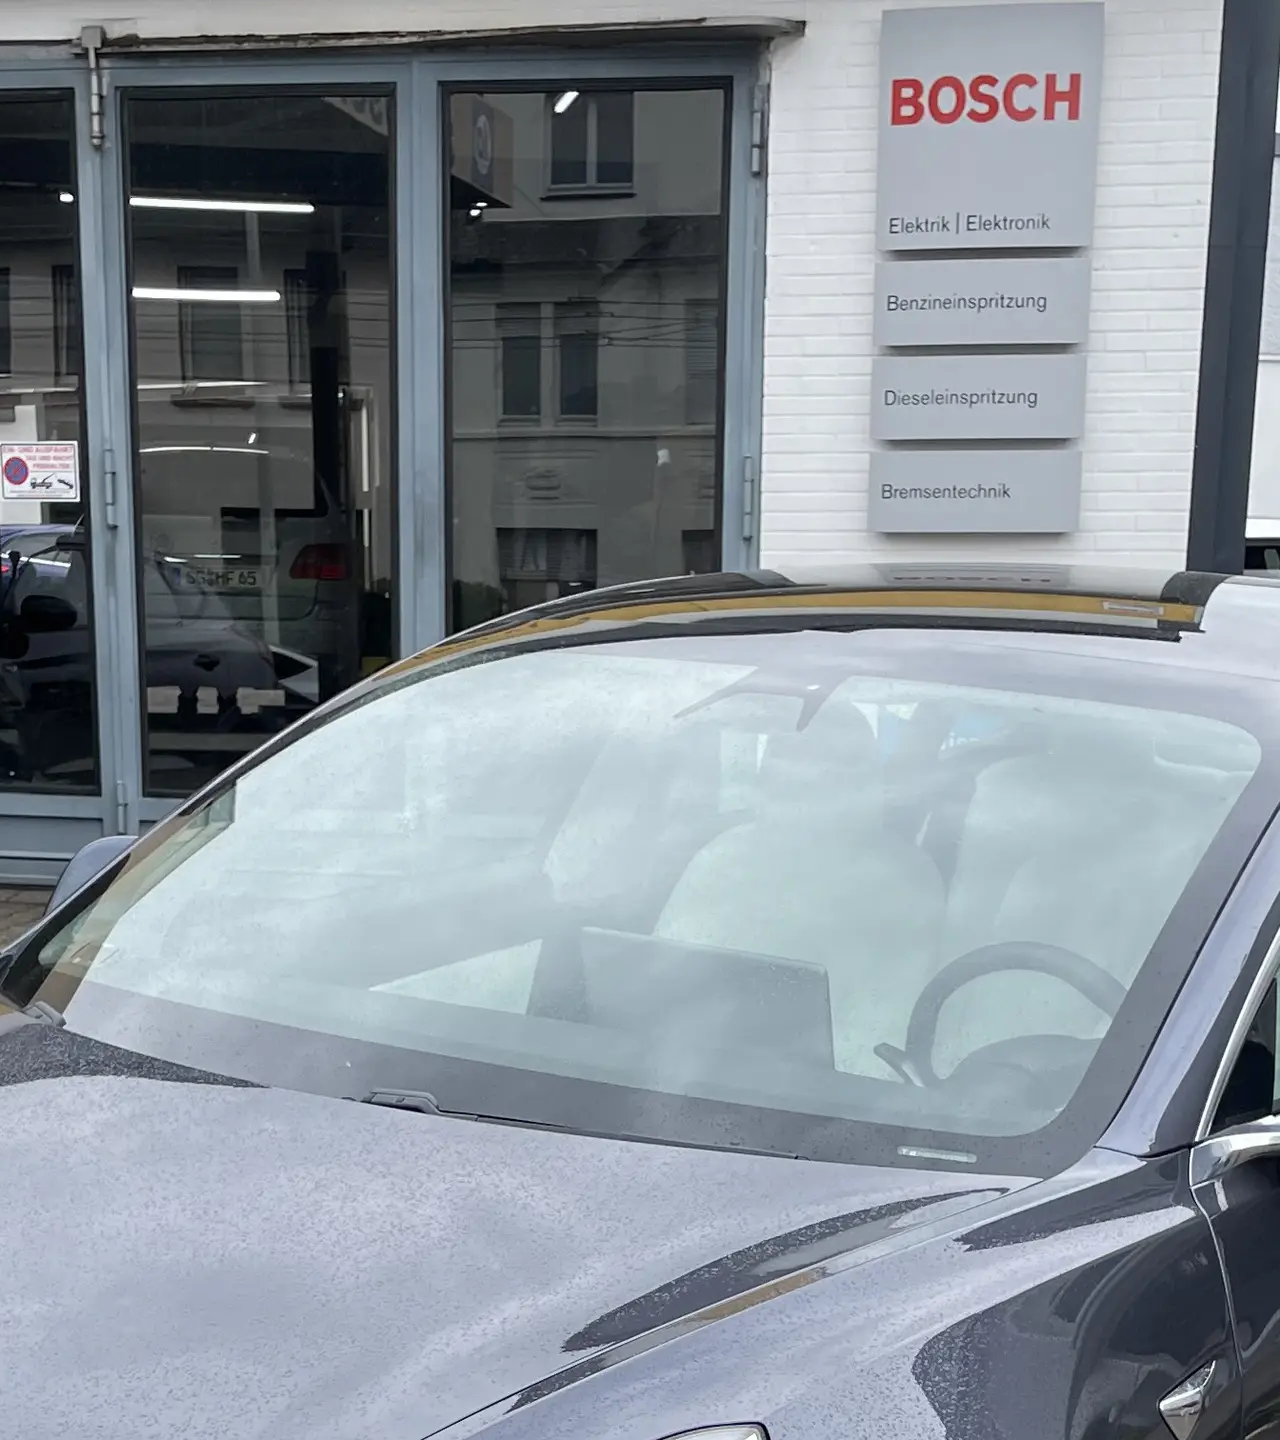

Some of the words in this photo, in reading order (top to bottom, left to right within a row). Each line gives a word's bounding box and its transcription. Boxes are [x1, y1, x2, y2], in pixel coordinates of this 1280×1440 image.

[891, 73, 1081, 126] BOSCH
[889, 217, 950, 234] Elektrik
[966, 214, 1051, 232] Elektronik
[887, 293, 1048, 313] Benzineinspritzung
[884, 388, 1038, 409] Dieseleinspritzung
[881, 483, 1011, 500] Bremsentechnik
